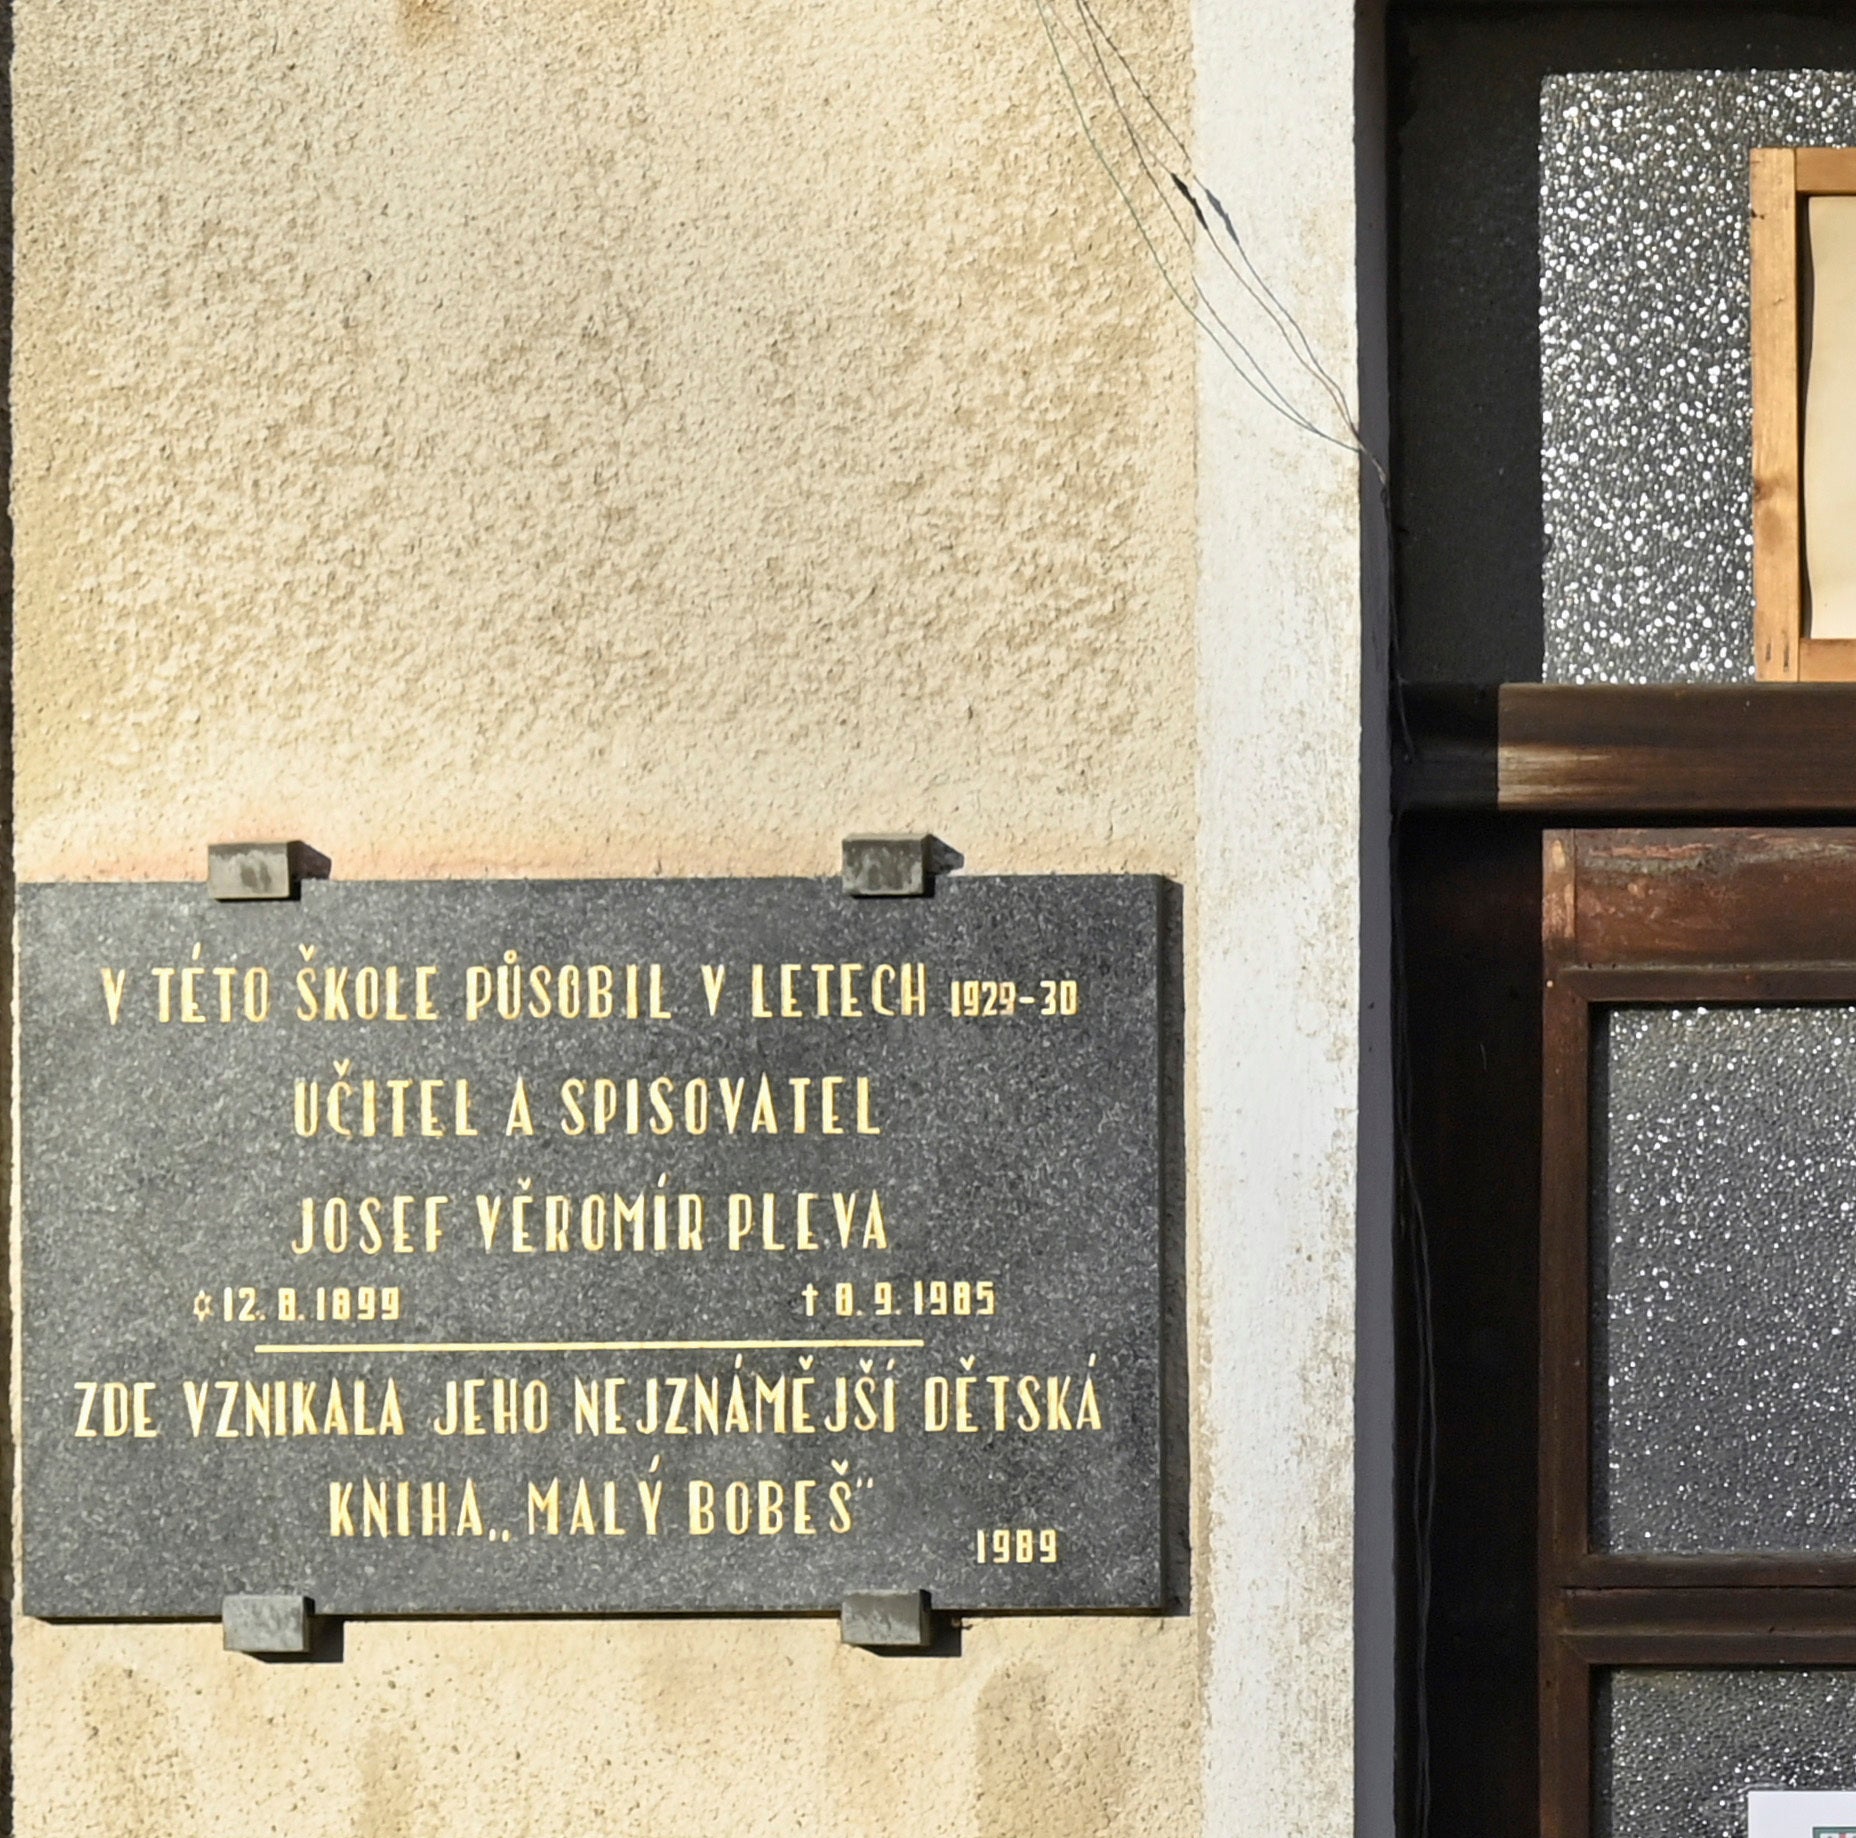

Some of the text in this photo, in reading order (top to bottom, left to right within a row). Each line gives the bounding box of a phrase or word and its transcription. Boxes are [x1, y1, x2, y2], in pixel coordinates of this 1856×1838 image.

[101, 942, 1078, 1025] V TÉTO ŠKOLE PŮSOBIL V LETECH 1929-30
[294, 1058, 881, 1137] UČITEL A SPISOVATEL
[292, 1172, 888, 1255] JOSEF VĚROMÍR PLEVA
[74, 1352, 1102, 1438] ZDE VZNIKALA JEHO NEJZNÁMĚJŠÍ DĚTSKÁ
[976, 1528, 1058, 1565] 1989
